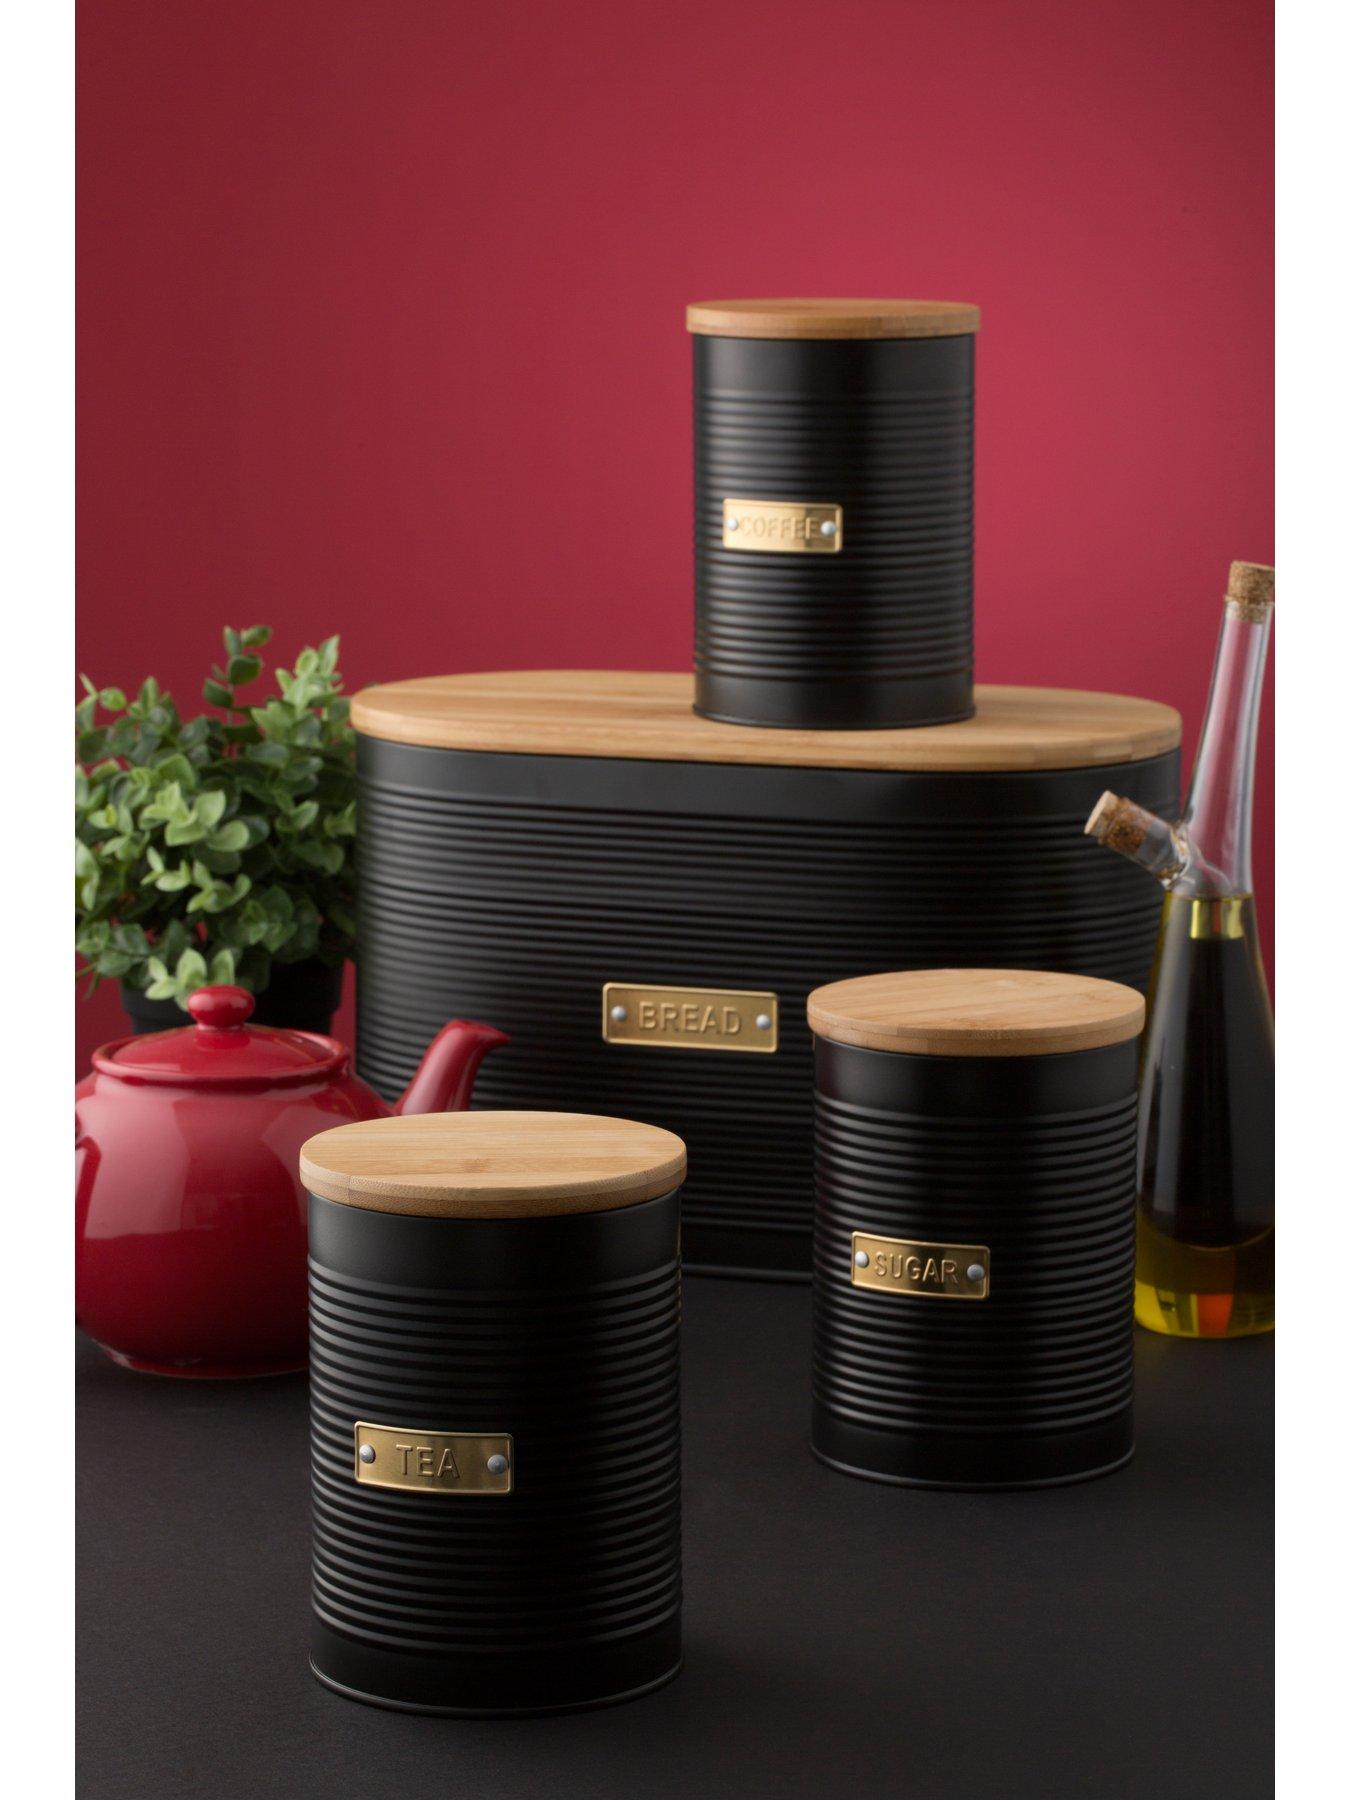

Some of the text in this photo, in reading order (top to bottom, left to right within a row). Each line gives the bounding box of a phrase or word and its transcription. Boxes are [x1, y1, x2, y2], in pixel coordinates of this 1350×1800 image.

[740, 516, 820, 540] COFFEE
[638, 1001, 742, 1035] BREAD
[874, 1250, 959, 1284] SUGAR
[395, 1443, 460, 1479] TEA
